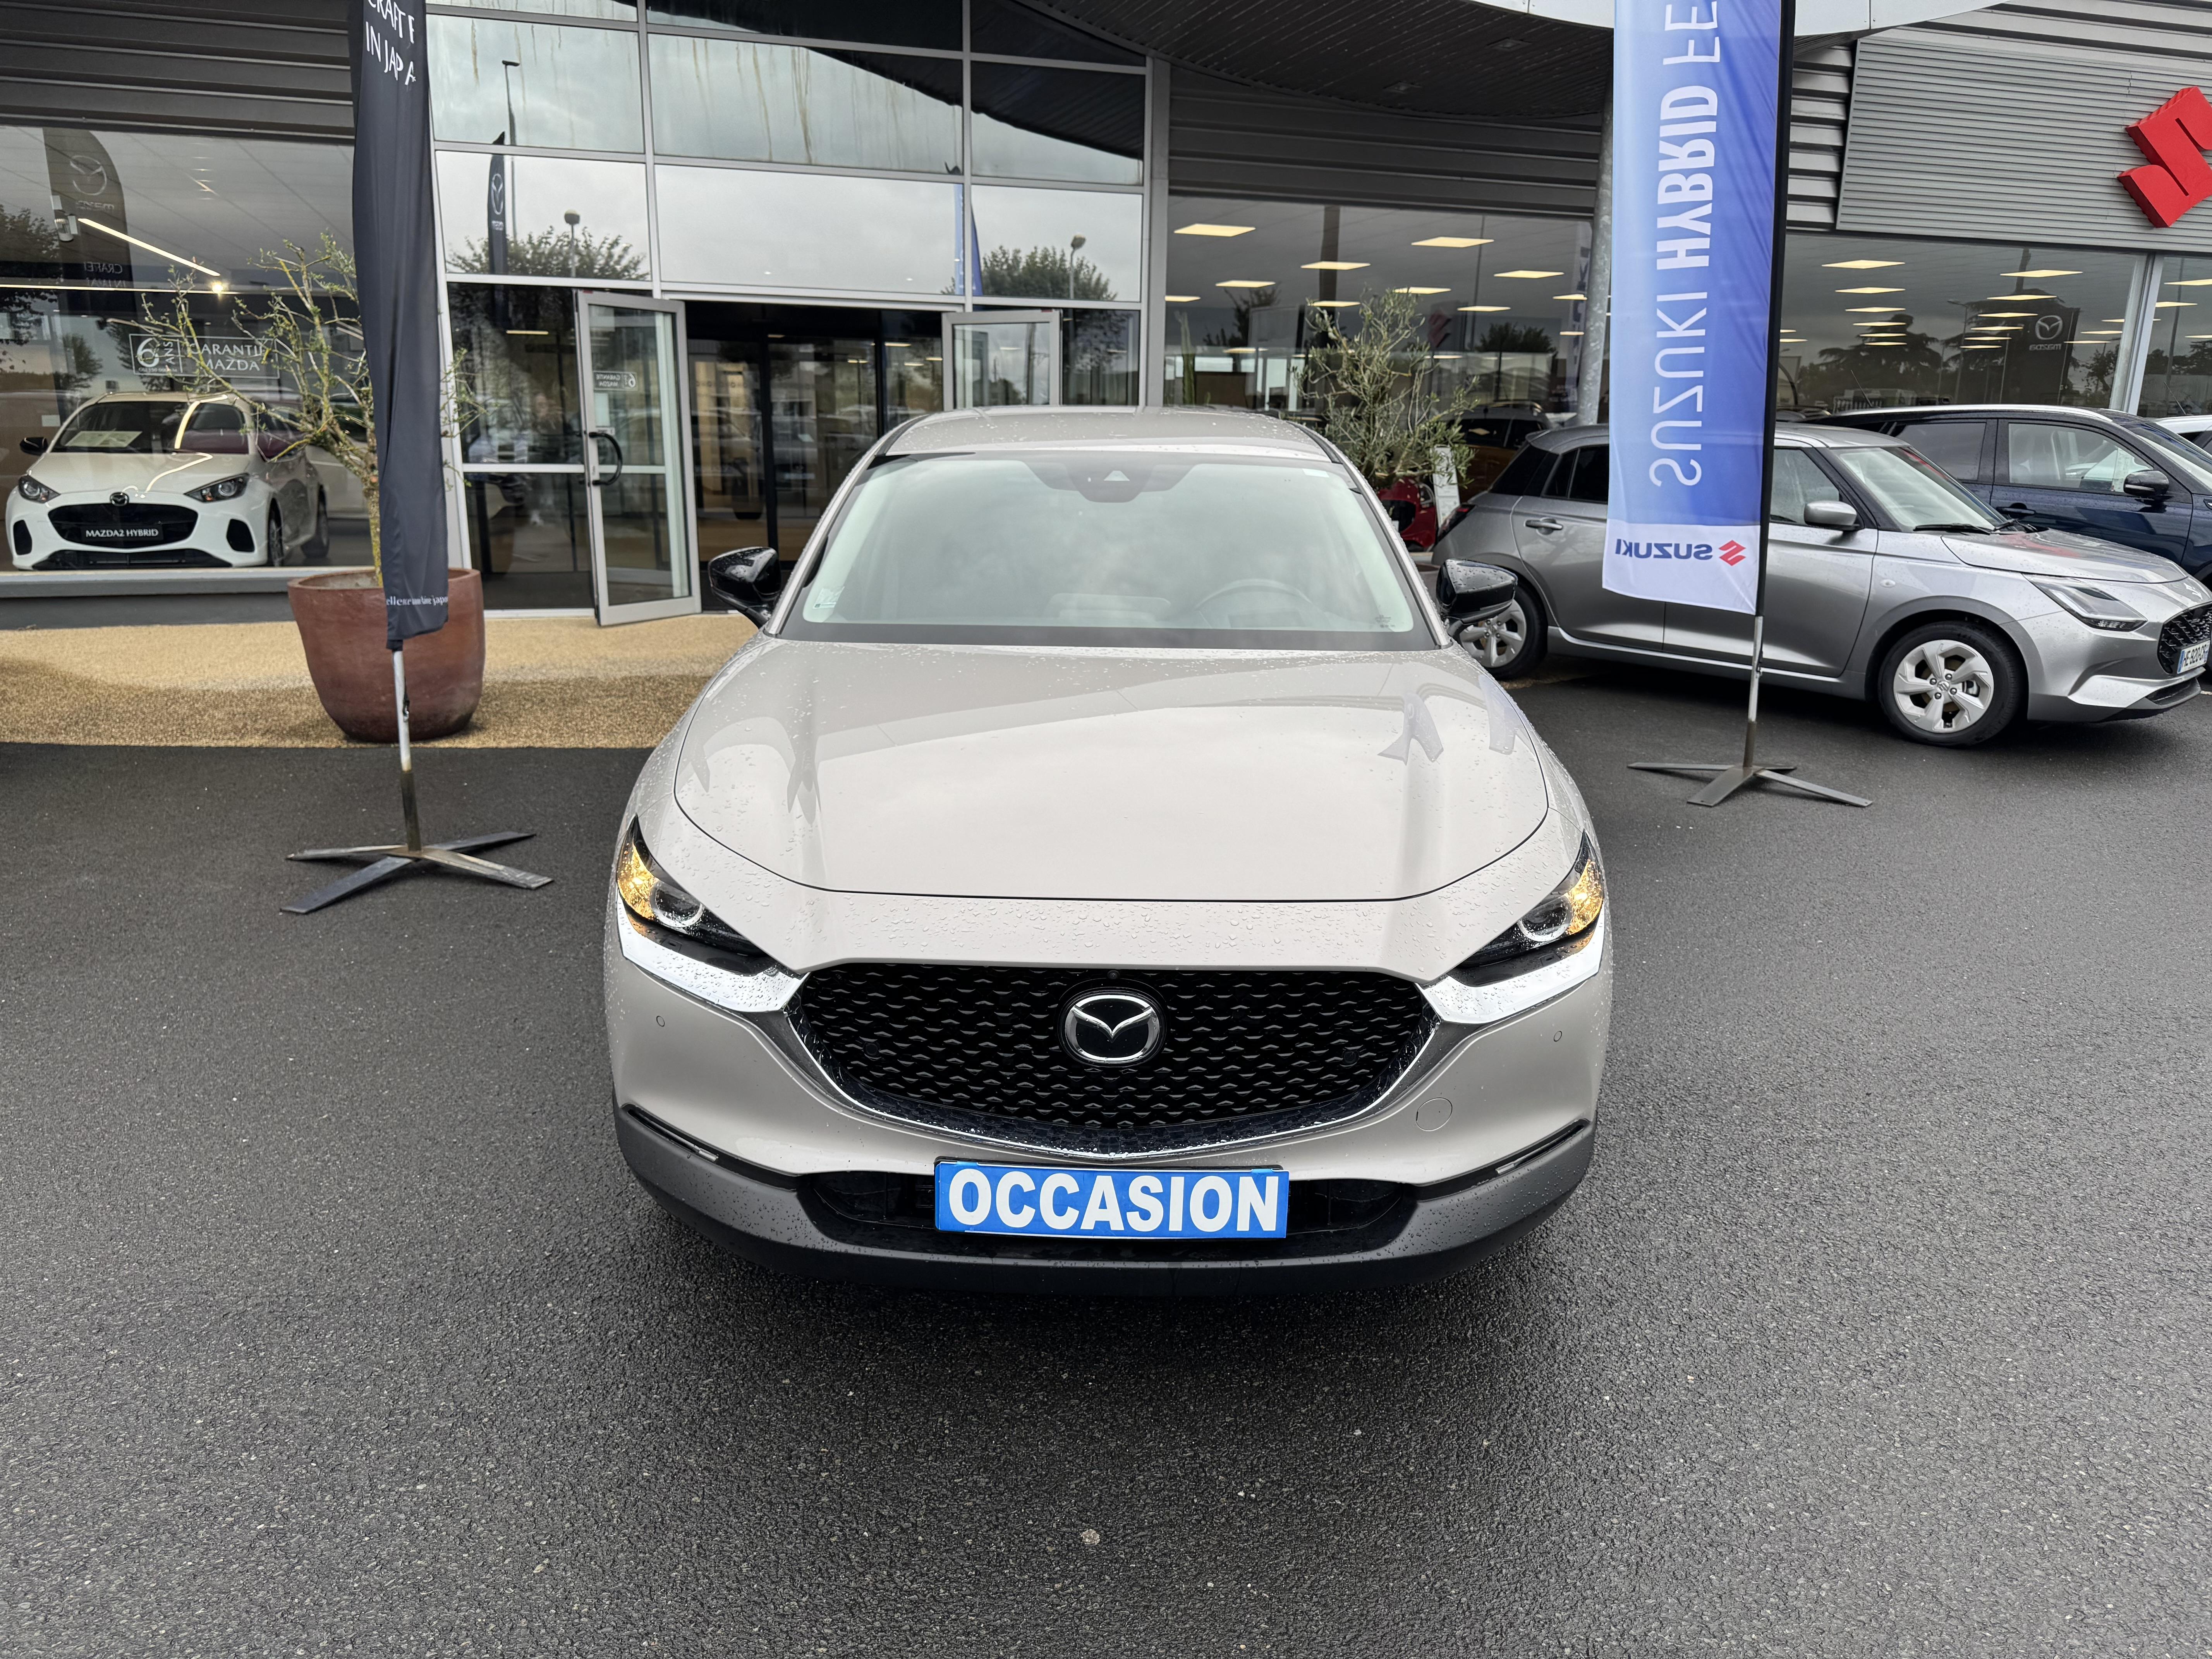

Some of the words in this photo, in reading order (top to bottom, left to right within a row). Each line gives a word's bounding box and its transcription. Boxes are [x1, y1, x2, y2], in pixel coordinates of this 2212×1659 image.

[366, 21, 381, 62] IN
[137, 337, 160, 368] 6
[163, 341, 176, 365] ANS
[949, 1169, 1278, 1232] OCCASION
